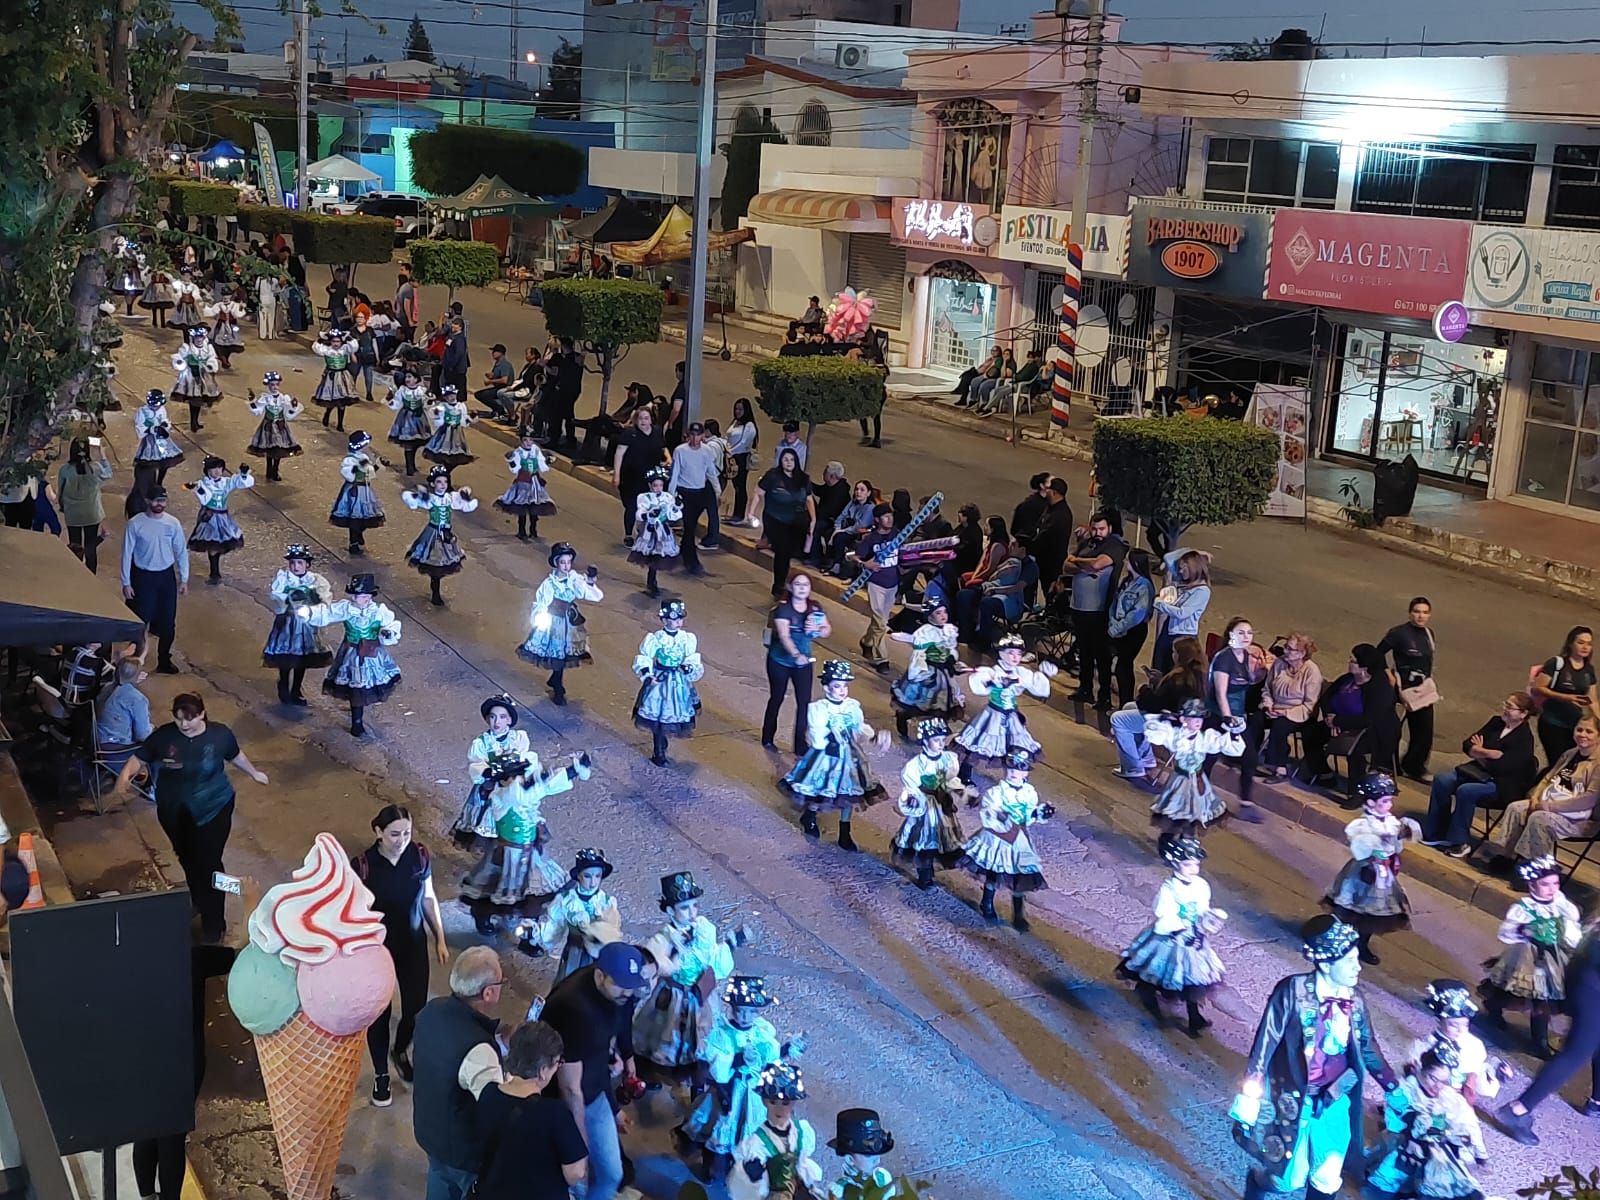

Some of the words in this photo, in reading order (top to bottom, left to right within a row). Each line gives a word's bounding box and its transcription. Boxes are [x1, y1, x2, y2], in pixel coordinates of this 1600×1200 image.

[1005, 213, 1109, 253] FIESTILAIA
[1146, 216, 1241, 248] BARBERSHOP
[1020, 241, 1044, 254] EVENTOS
[1174, 250, 1205, 269] 1907
[1316, 239, 1451, 274] MAGENTA
[1441, 323, 1465, 331] MAGENTA
